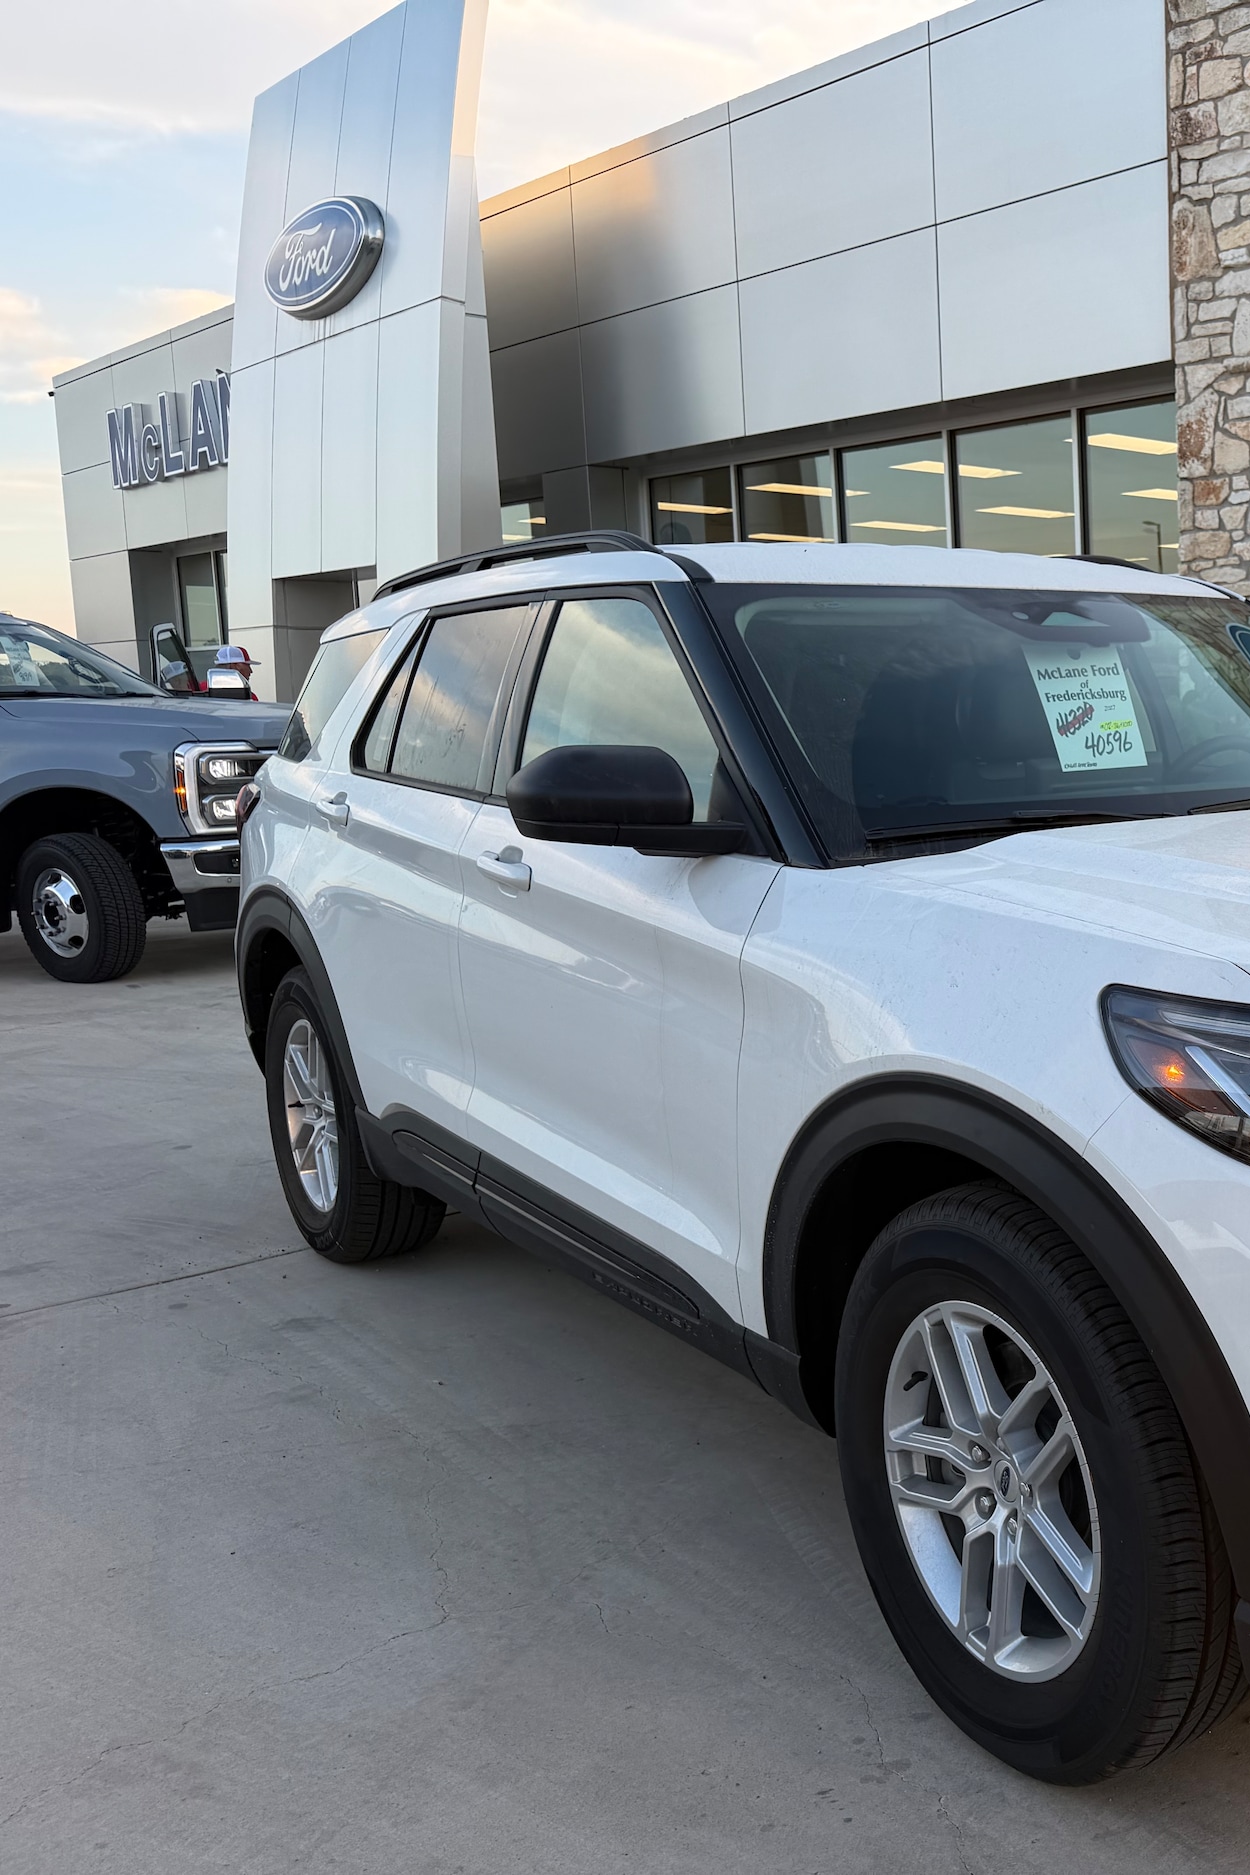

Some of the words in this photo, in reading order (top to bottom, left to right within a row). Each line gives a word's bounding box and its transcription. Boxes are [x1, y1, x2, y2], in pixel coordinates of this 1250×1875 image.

[279, 222, 336, 292] Ford
[1036, 665, 1088, 681] McLane
[1090, 663, 1120, 677] Ford
[1080, 679, 1089, 689] of
[1045, 688, 1127, 702] Fredericksburg
[1085, 730, 1133, 758] 40596
